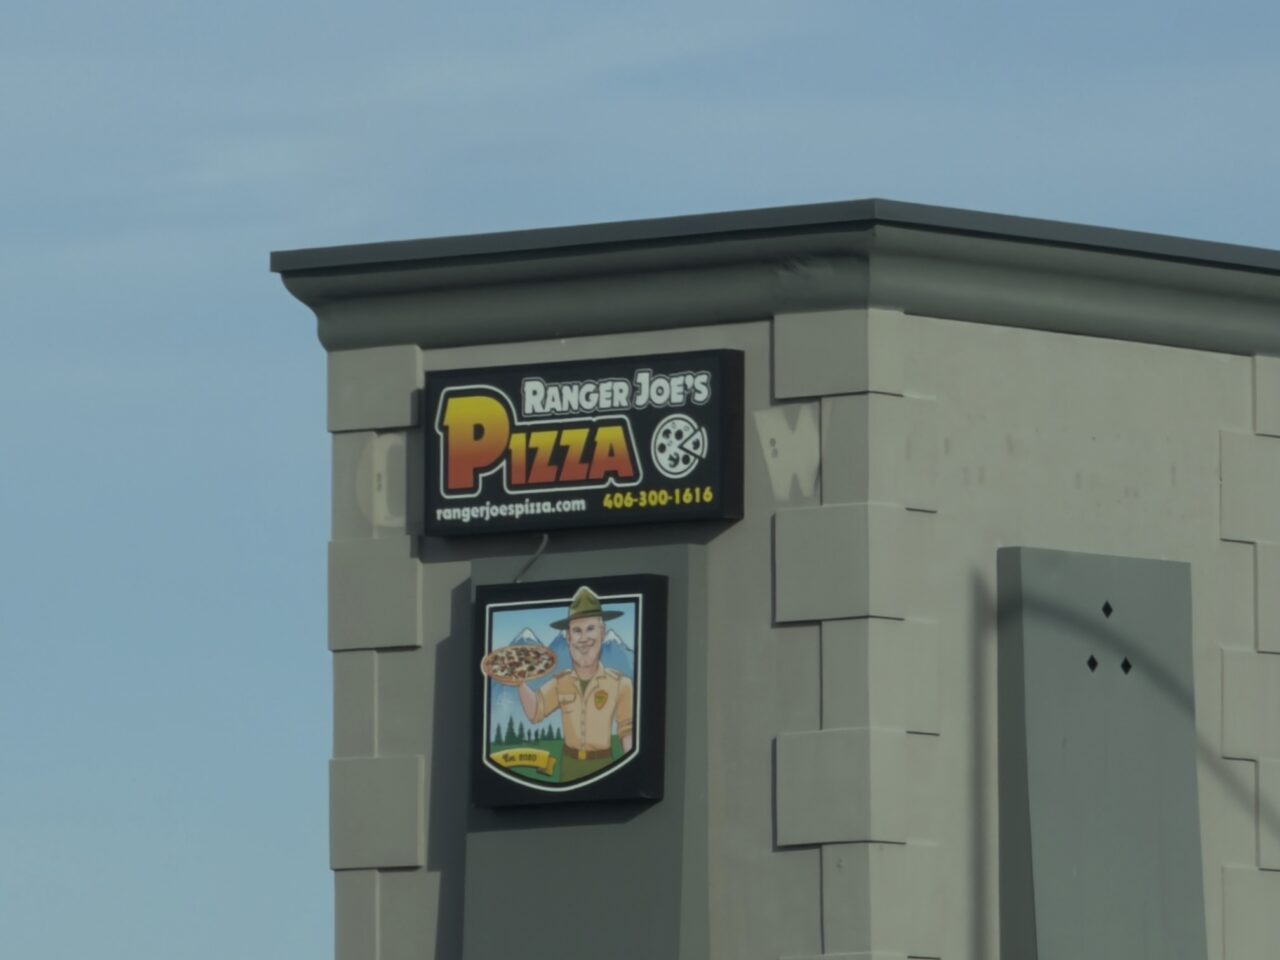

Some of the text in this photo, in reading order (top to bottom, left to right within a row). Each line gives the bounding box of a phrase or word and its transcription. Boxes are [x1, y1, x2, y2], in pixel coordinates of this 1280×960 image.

[522, 369, 711, 416] RANGER JOE'S
[440, 392, 637, 493] PIZZA
[436, 498, 586, 522] rangerjoespizza.com
[603, 487, 713, 509] 406-300-1616
